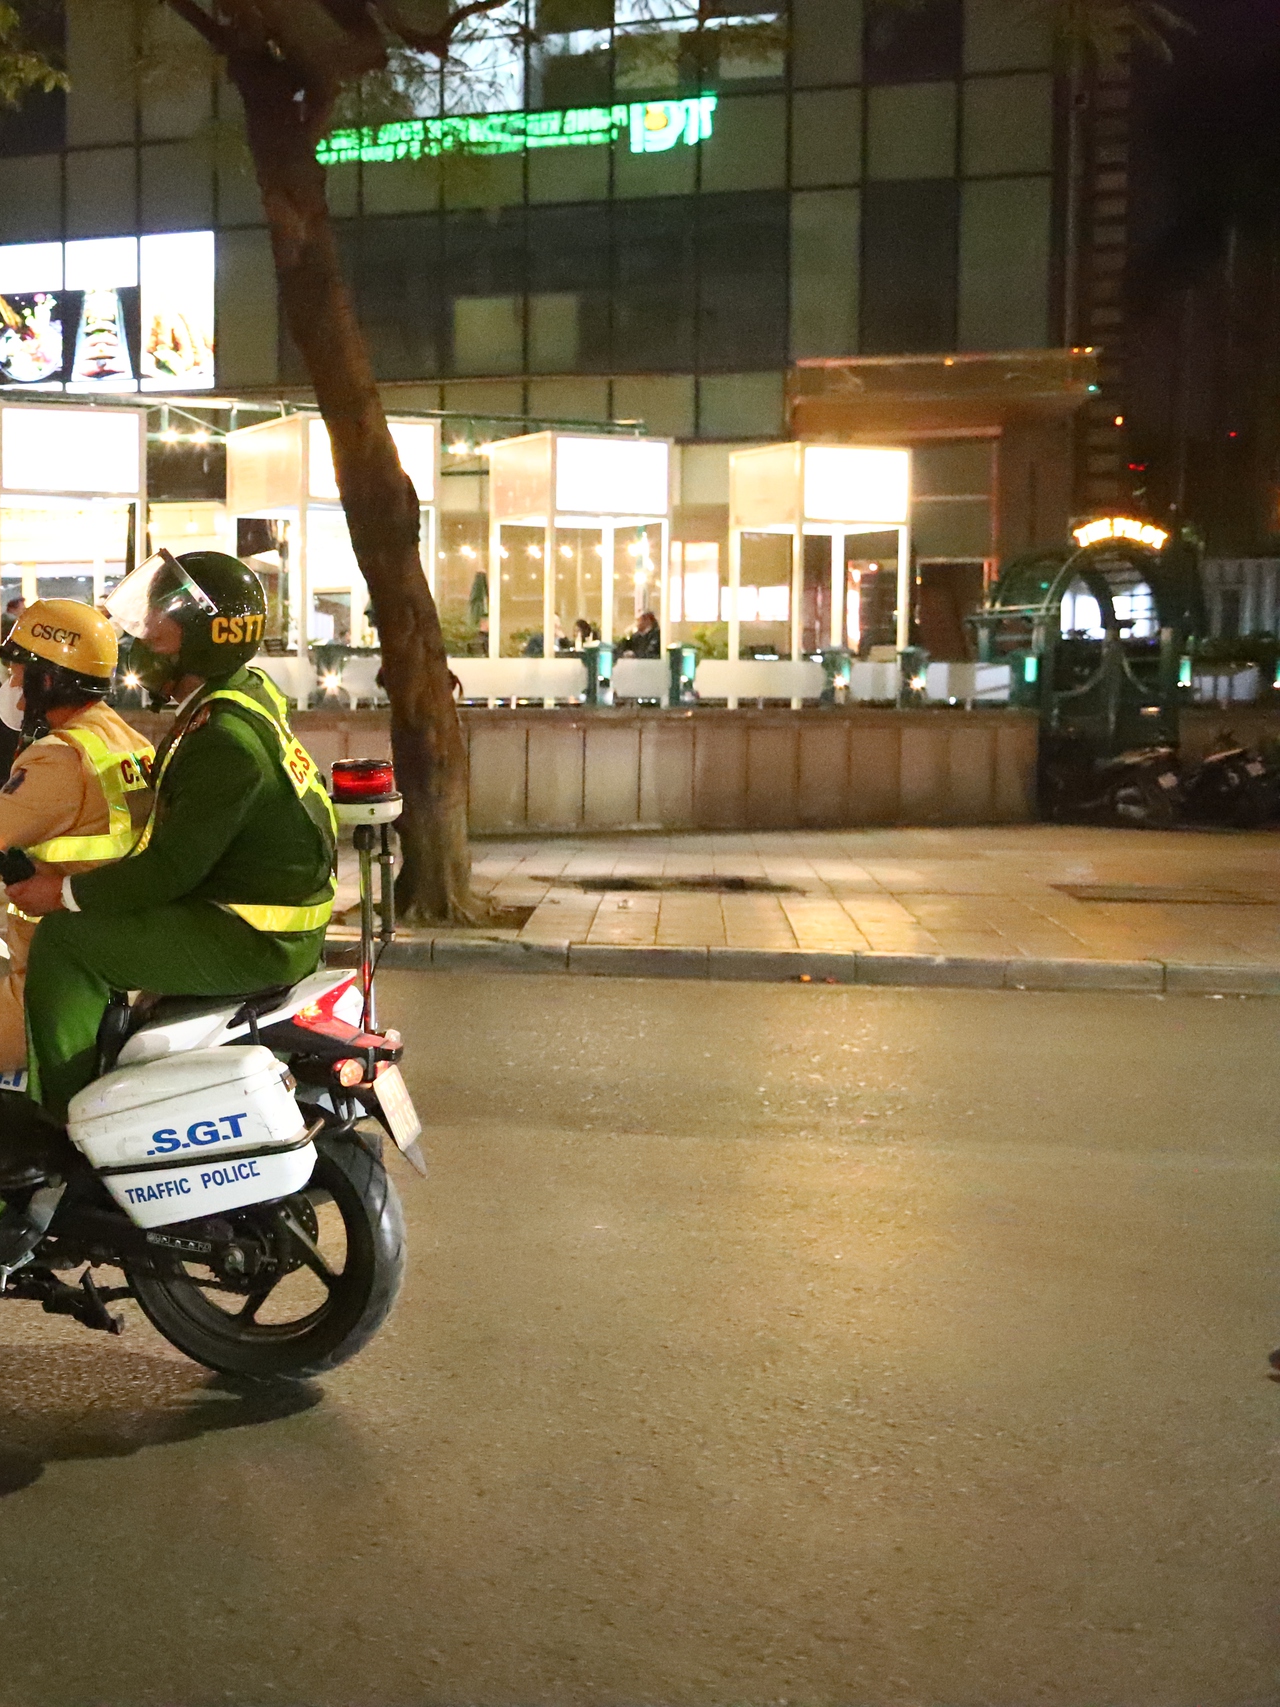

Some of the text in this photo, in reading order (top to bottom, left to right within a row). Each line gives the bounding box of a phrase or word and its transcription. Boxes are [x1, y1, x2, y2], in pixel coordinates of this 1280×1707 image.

[31, 623, 81, 647] CSGT
[212, 614, 263, 643] CSTT
[125, 1160, 260, 1204] TRAFFIC POLICE
